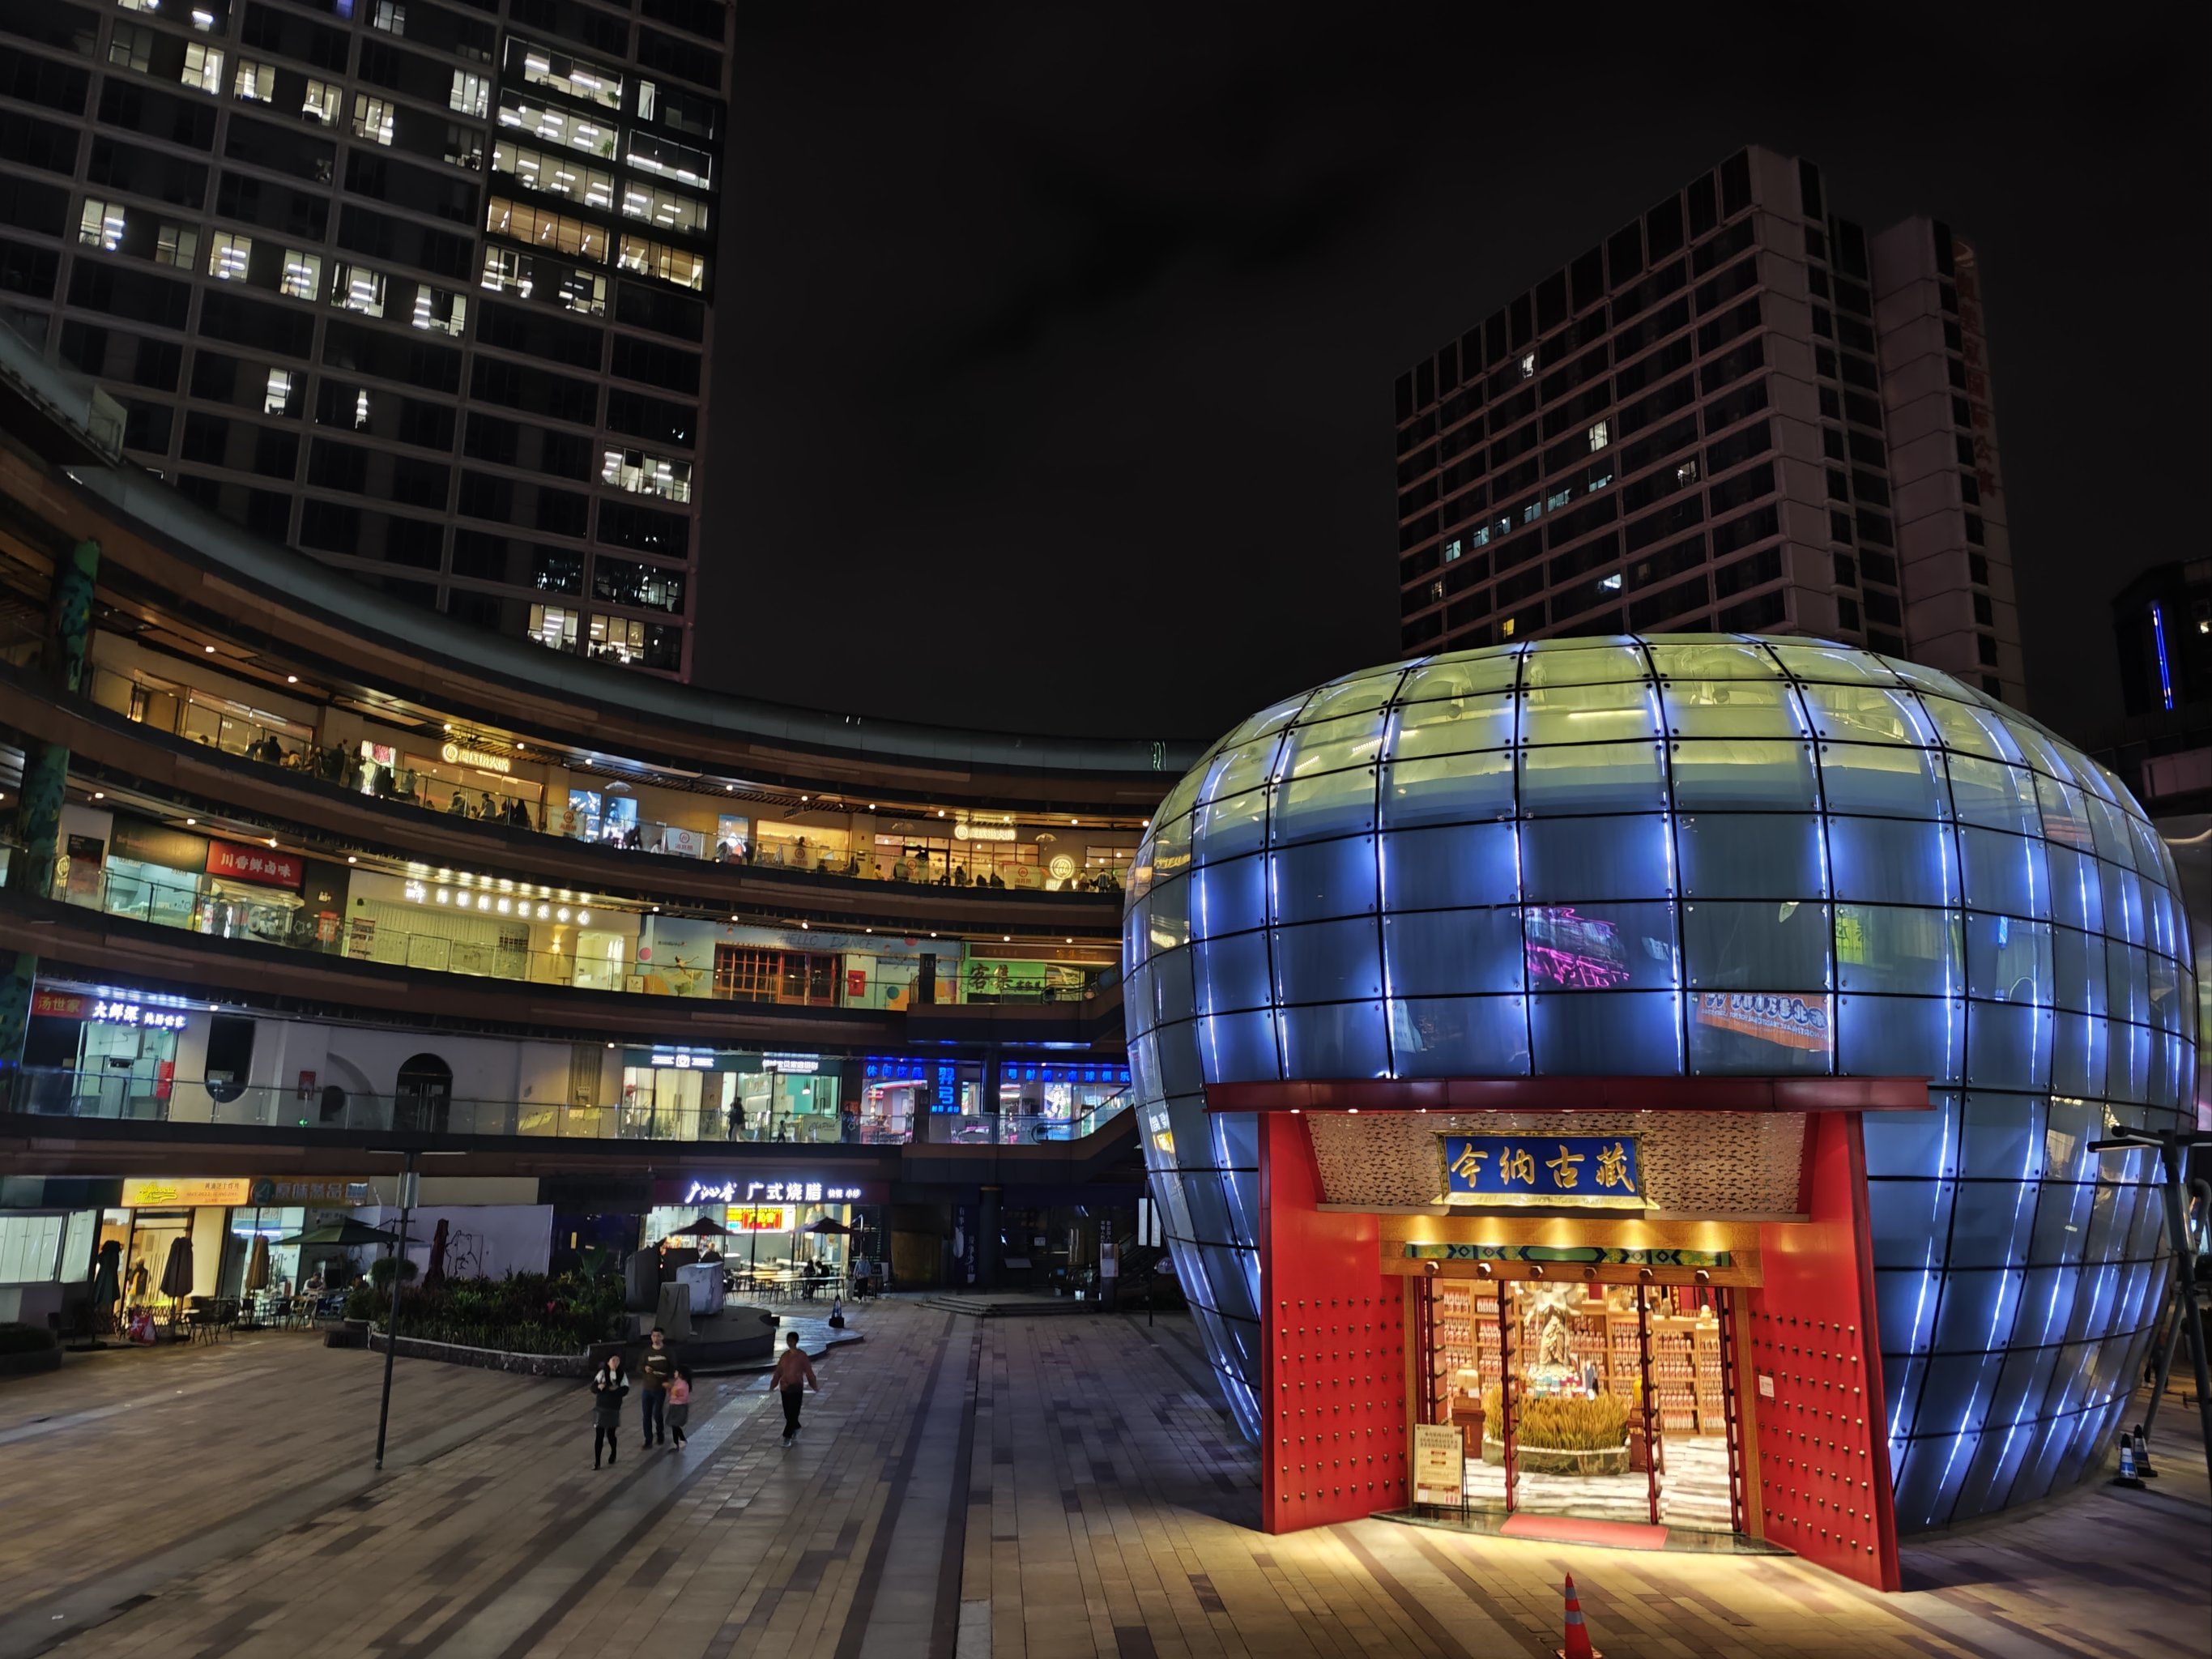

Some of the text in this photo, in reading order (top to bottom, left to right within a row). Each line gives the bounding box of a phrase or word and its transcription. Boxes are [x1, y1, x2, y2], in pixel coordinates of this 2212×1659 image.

[220, 853, 291, 877] 川香鲜卤味
[778, 932, 876, 950] HELLO DANCE
[38, 996, 80, 1013] 汤世家
[747, 1181, 822, 1201] 广式烧腊
